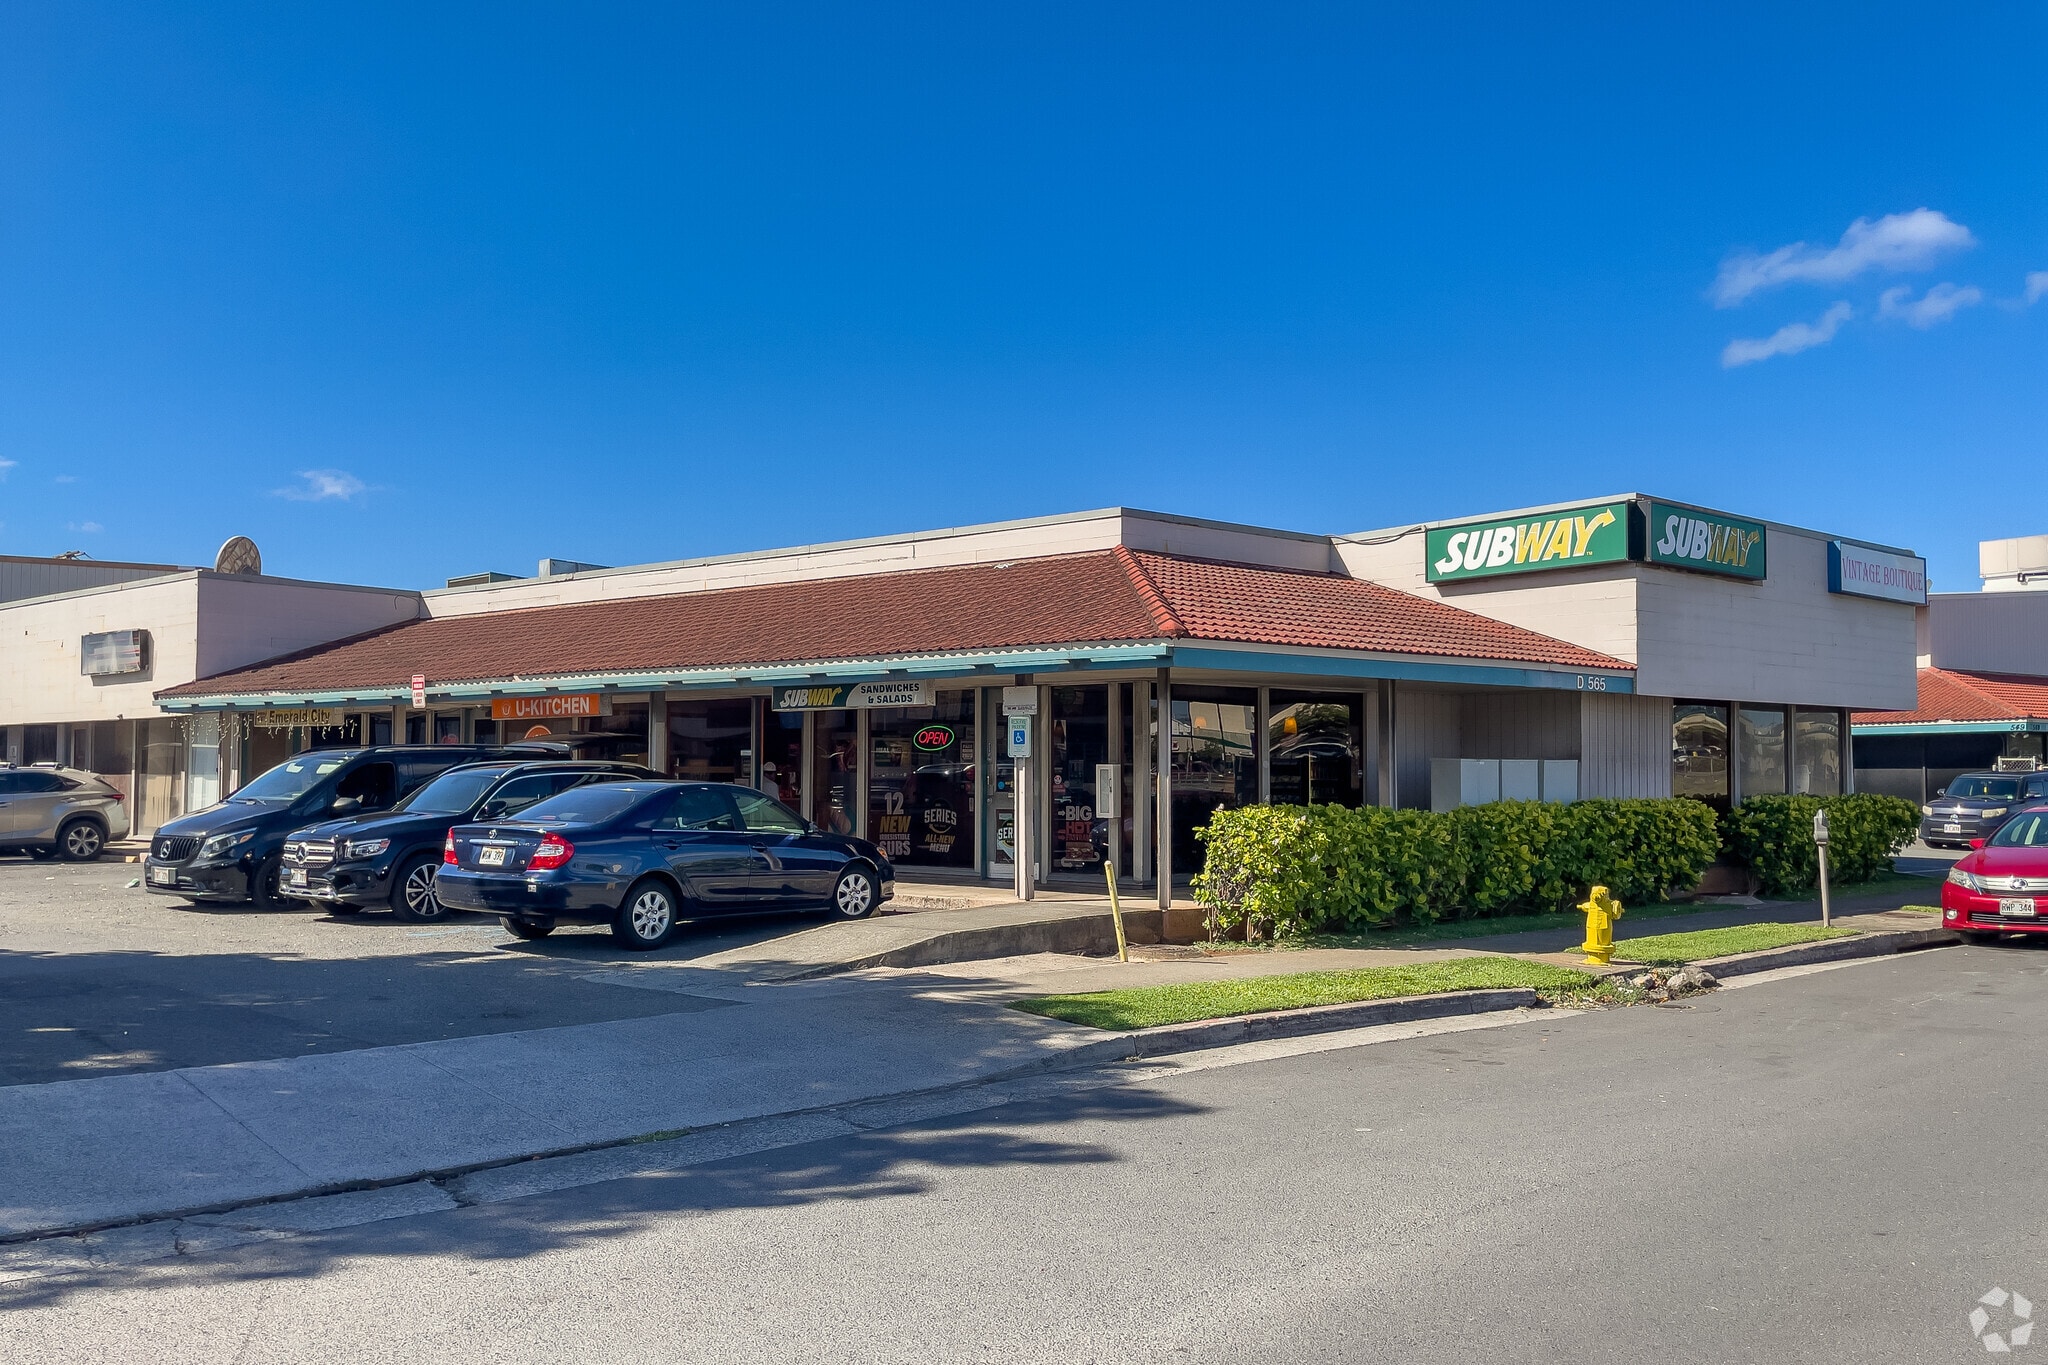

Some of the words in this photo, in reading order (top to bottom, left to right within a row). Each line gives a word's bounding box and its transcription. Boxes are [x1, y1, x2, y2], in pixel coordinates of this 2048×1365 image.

[1434, 508, 1616, 577] SUBWAY
[1657, 514, 1760, 568] SUBWAY
[1842, 556, 1880, 584] VINTAGE
[1883, 566, 1923, 592] BOUTIQUE
[860, 683, 920, 694] SANDWICHES
[1577, 675, 1584, 689] D
[1588, 676, 1606, 691] 565
[779, 686, 843, 708] SUBWAY
[868, 695, 874, 704] &
[877, 694, 913, 704] SALADS
[516, 697, 590, 716] U-KITCHEN
[269, 709, 307, 723] Emerald
[311, 708, 330, 724] City
[918, 731, 948, 745] OPEN
[884, 792, 904, 815] 12
[924, 808, 957, 826] SERIES
[1065, 805, 1092, 821] BIG
[880, 816, 911, 833] NEW
[1066, 821, 1092, 834] HOT
[998, 827, 1013, 839] SER
